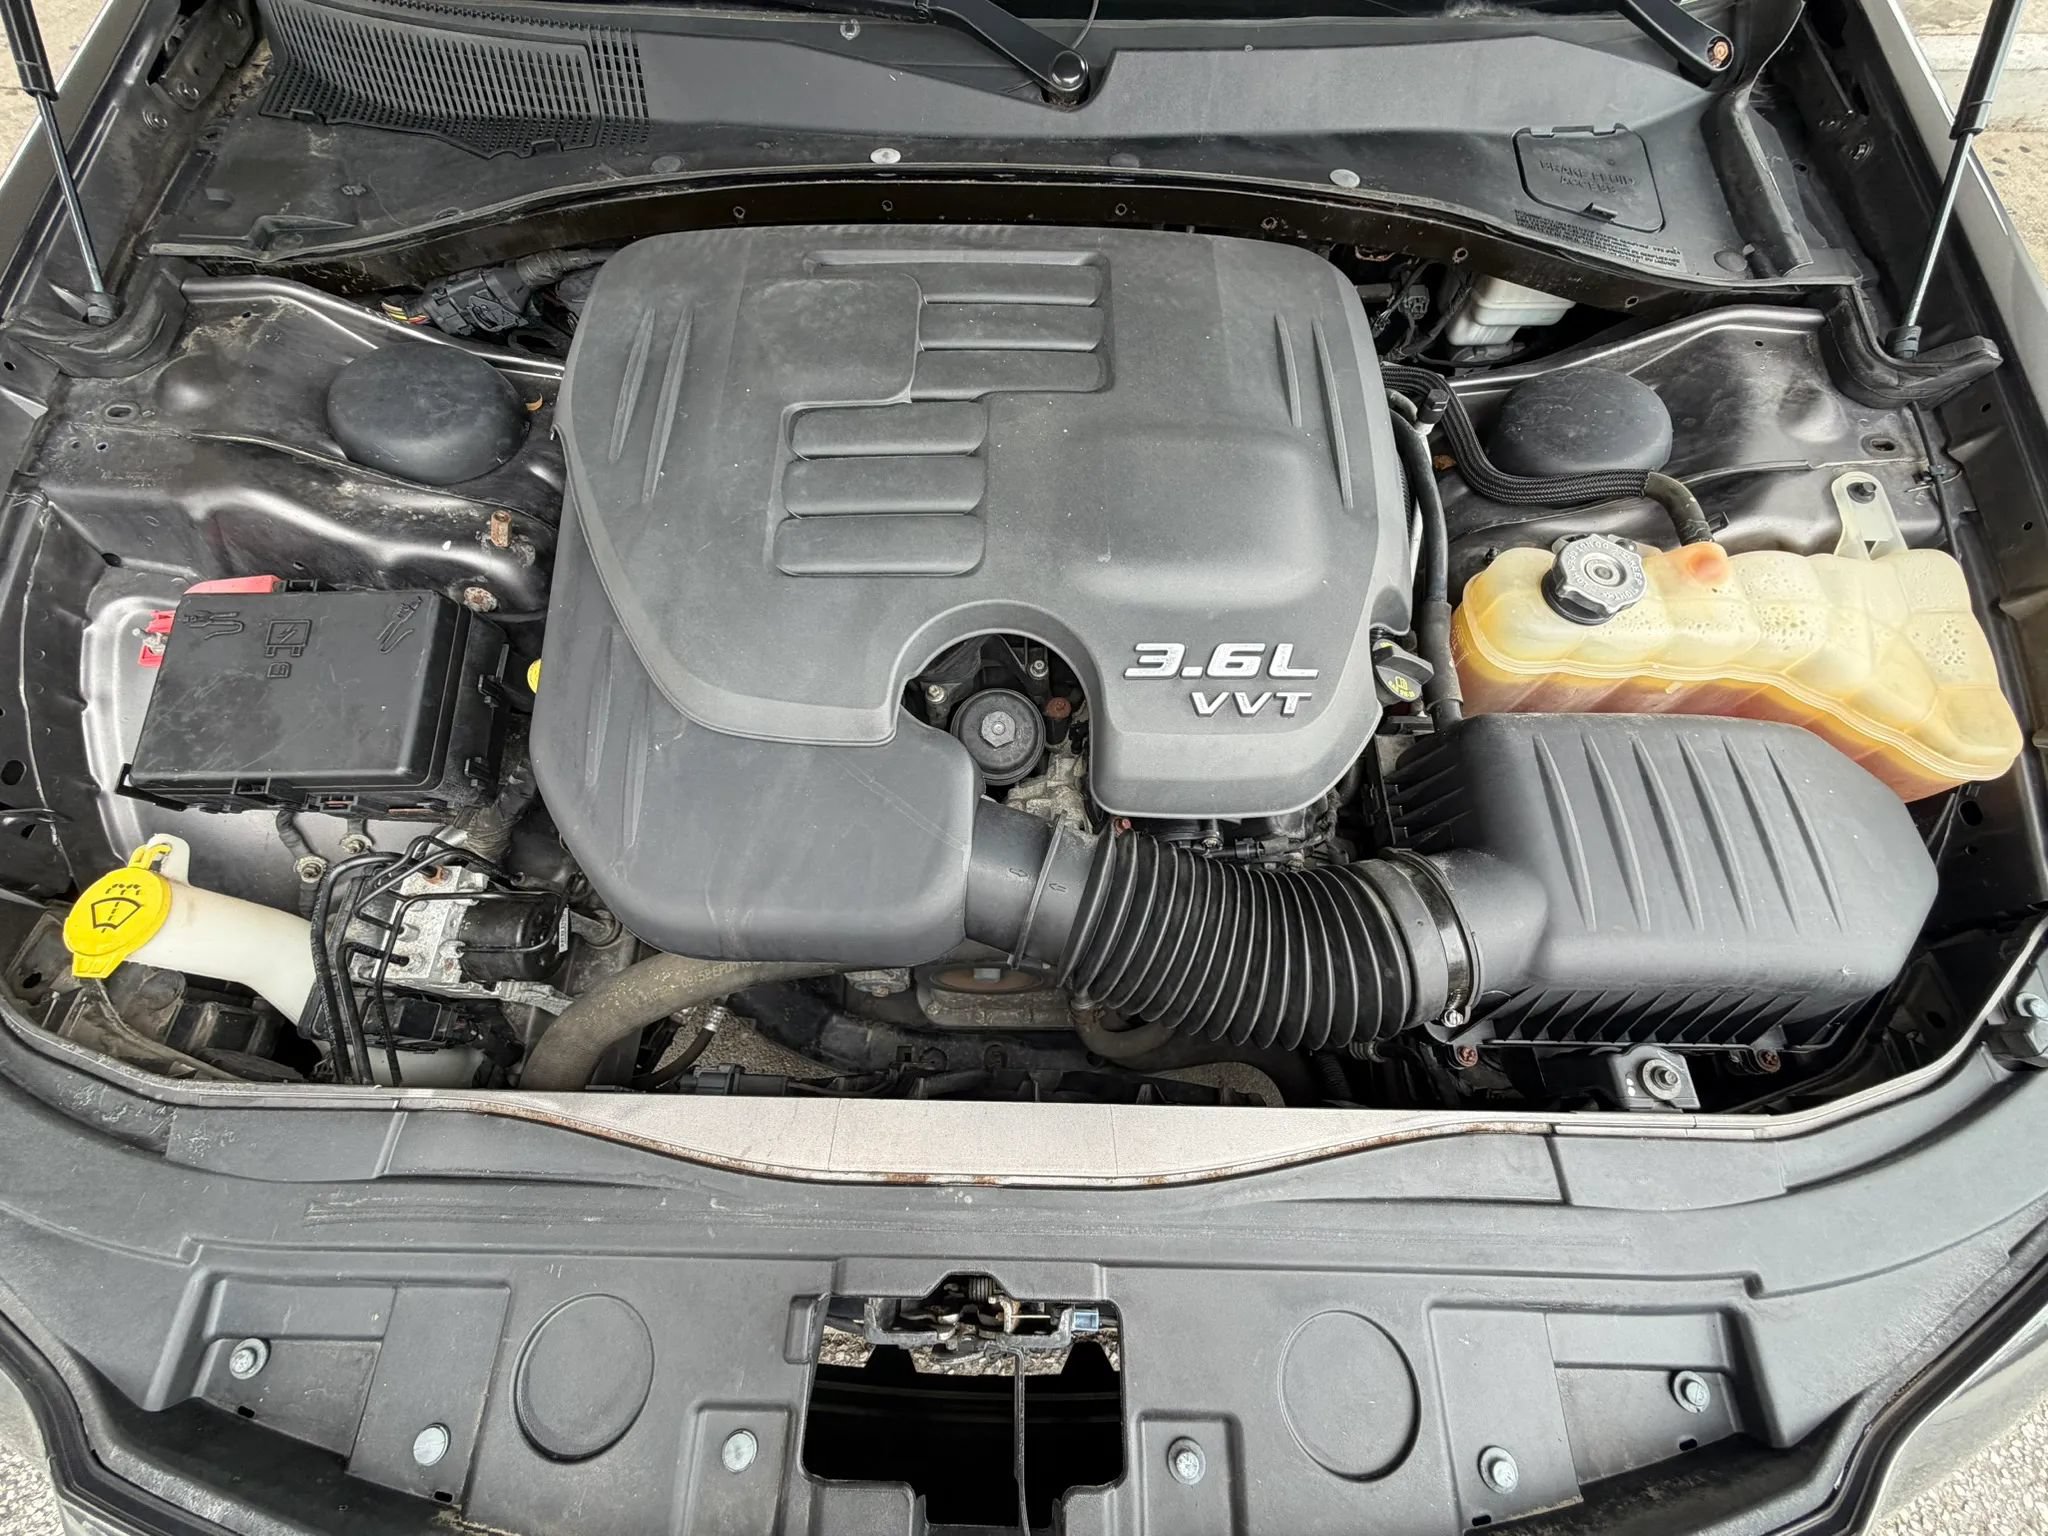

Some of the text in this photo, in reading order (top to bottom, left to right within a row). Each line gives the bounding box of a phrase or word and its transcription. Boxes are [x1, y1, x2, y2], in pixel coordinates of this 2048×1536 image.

[1539, 159, 1634, 186] BRAKE FLUID
[1559, 175, 1616, 194] ACCESS
[1124, 642, 1319, 678] 3.6L
[1190, 691, 1312, 717] VVT
